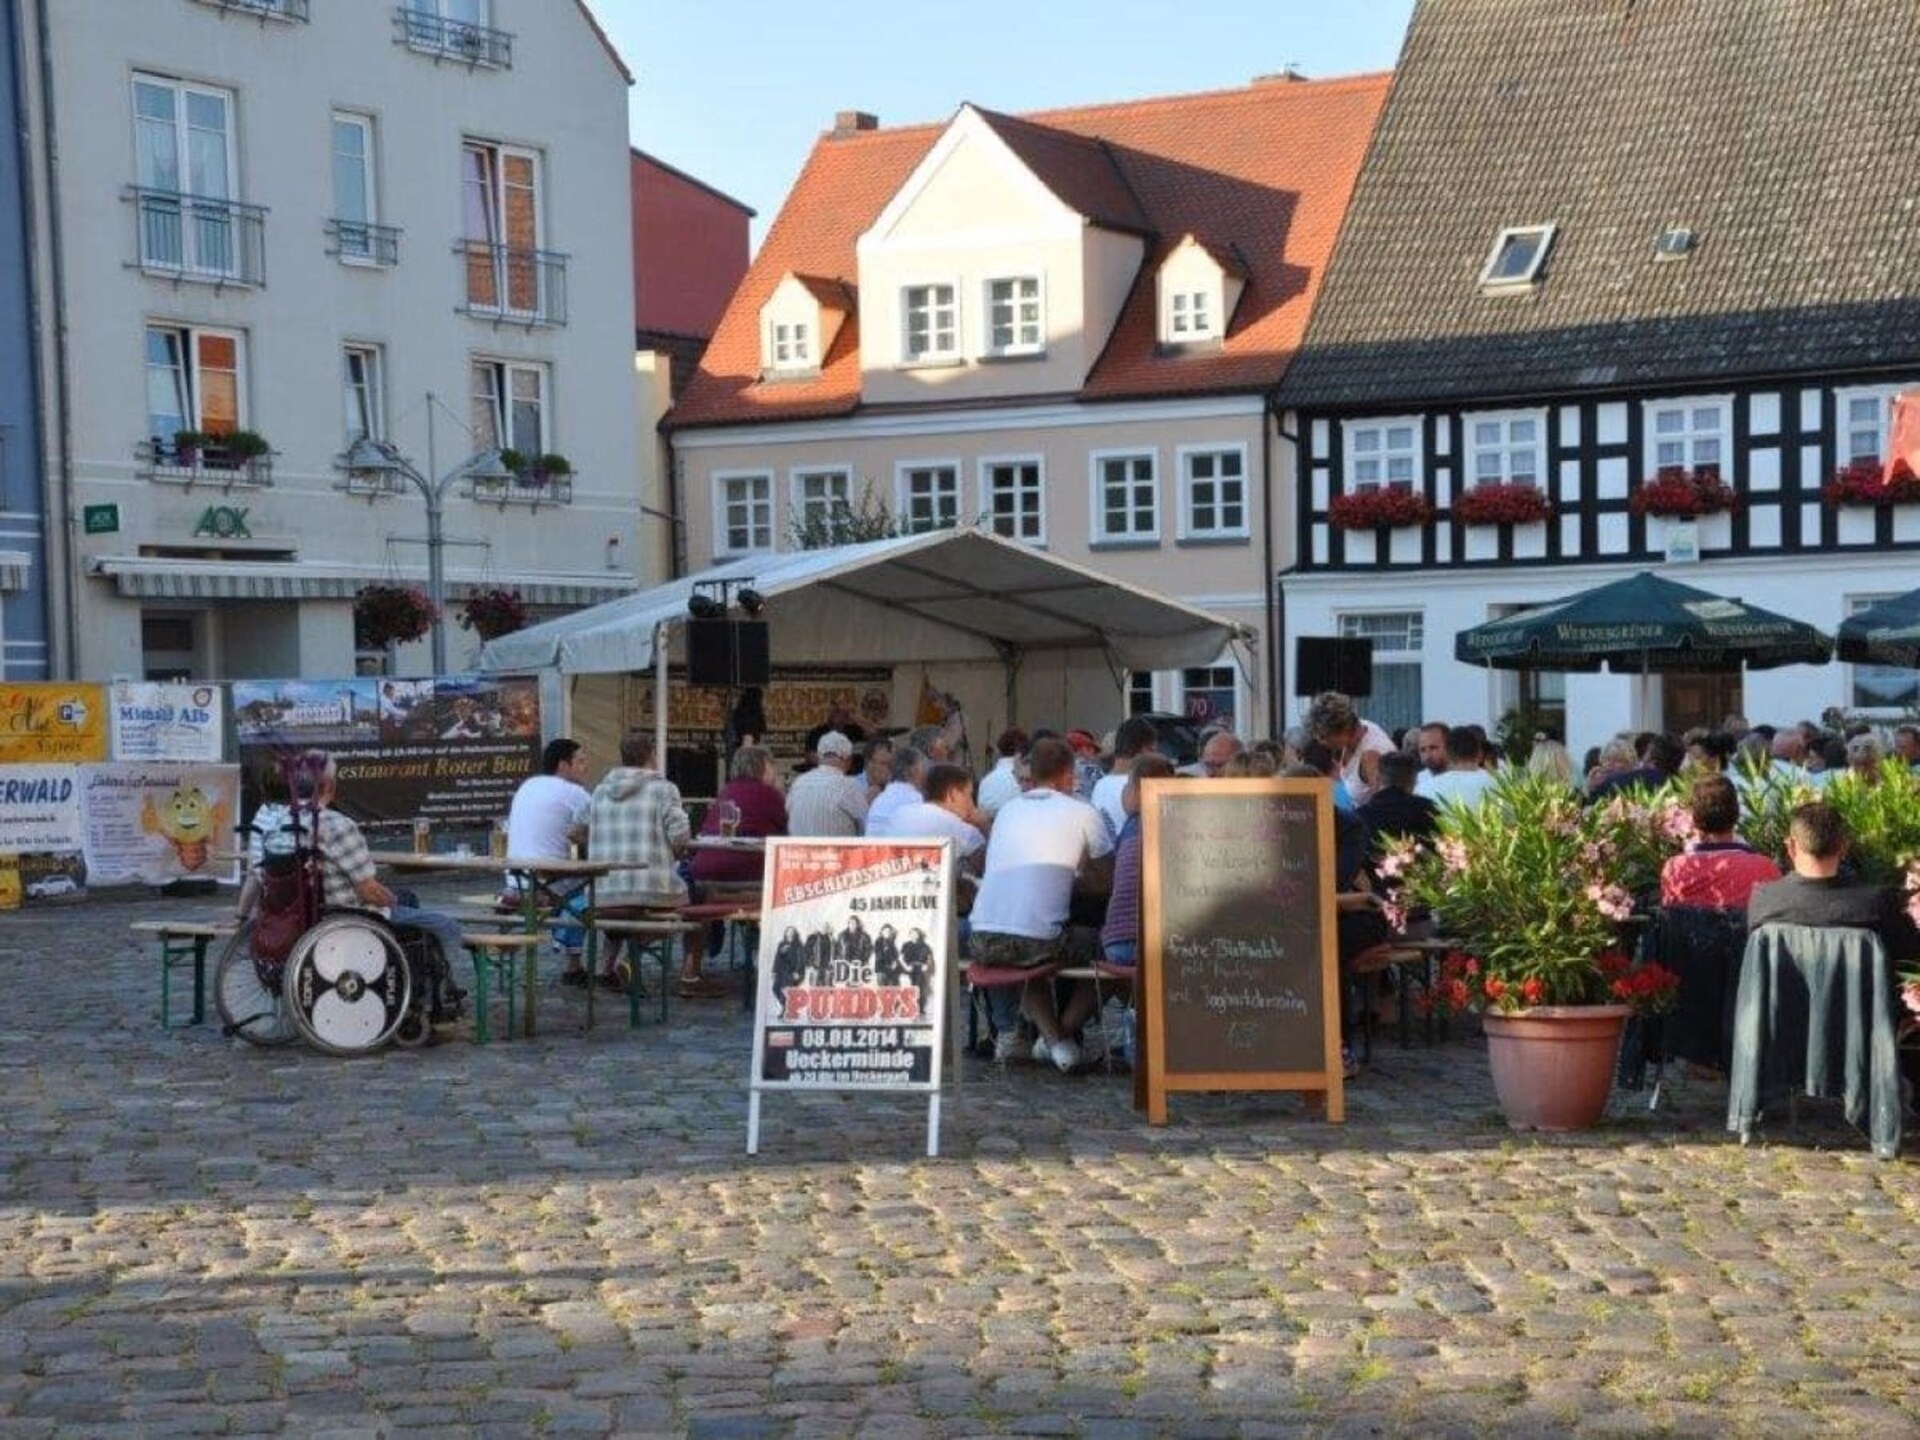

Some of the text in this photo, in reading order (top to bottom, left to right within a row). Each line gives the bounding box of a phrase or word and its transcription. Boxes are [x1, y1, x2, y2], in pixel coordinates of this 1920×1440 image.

[193, 505, 252, 538] AOK
[337, 756, 532, 780] estaurant Roter Butt
[850, 895, 939, 912] 45 JAHRE LIVE
[833, 960, 872, 983] Die
[784, 986, 920, 1021] PUHDYS
[802, 1029, 898, 1047] 08.08.2014
[786, 1049, 914, 1069] Ueckermünde
